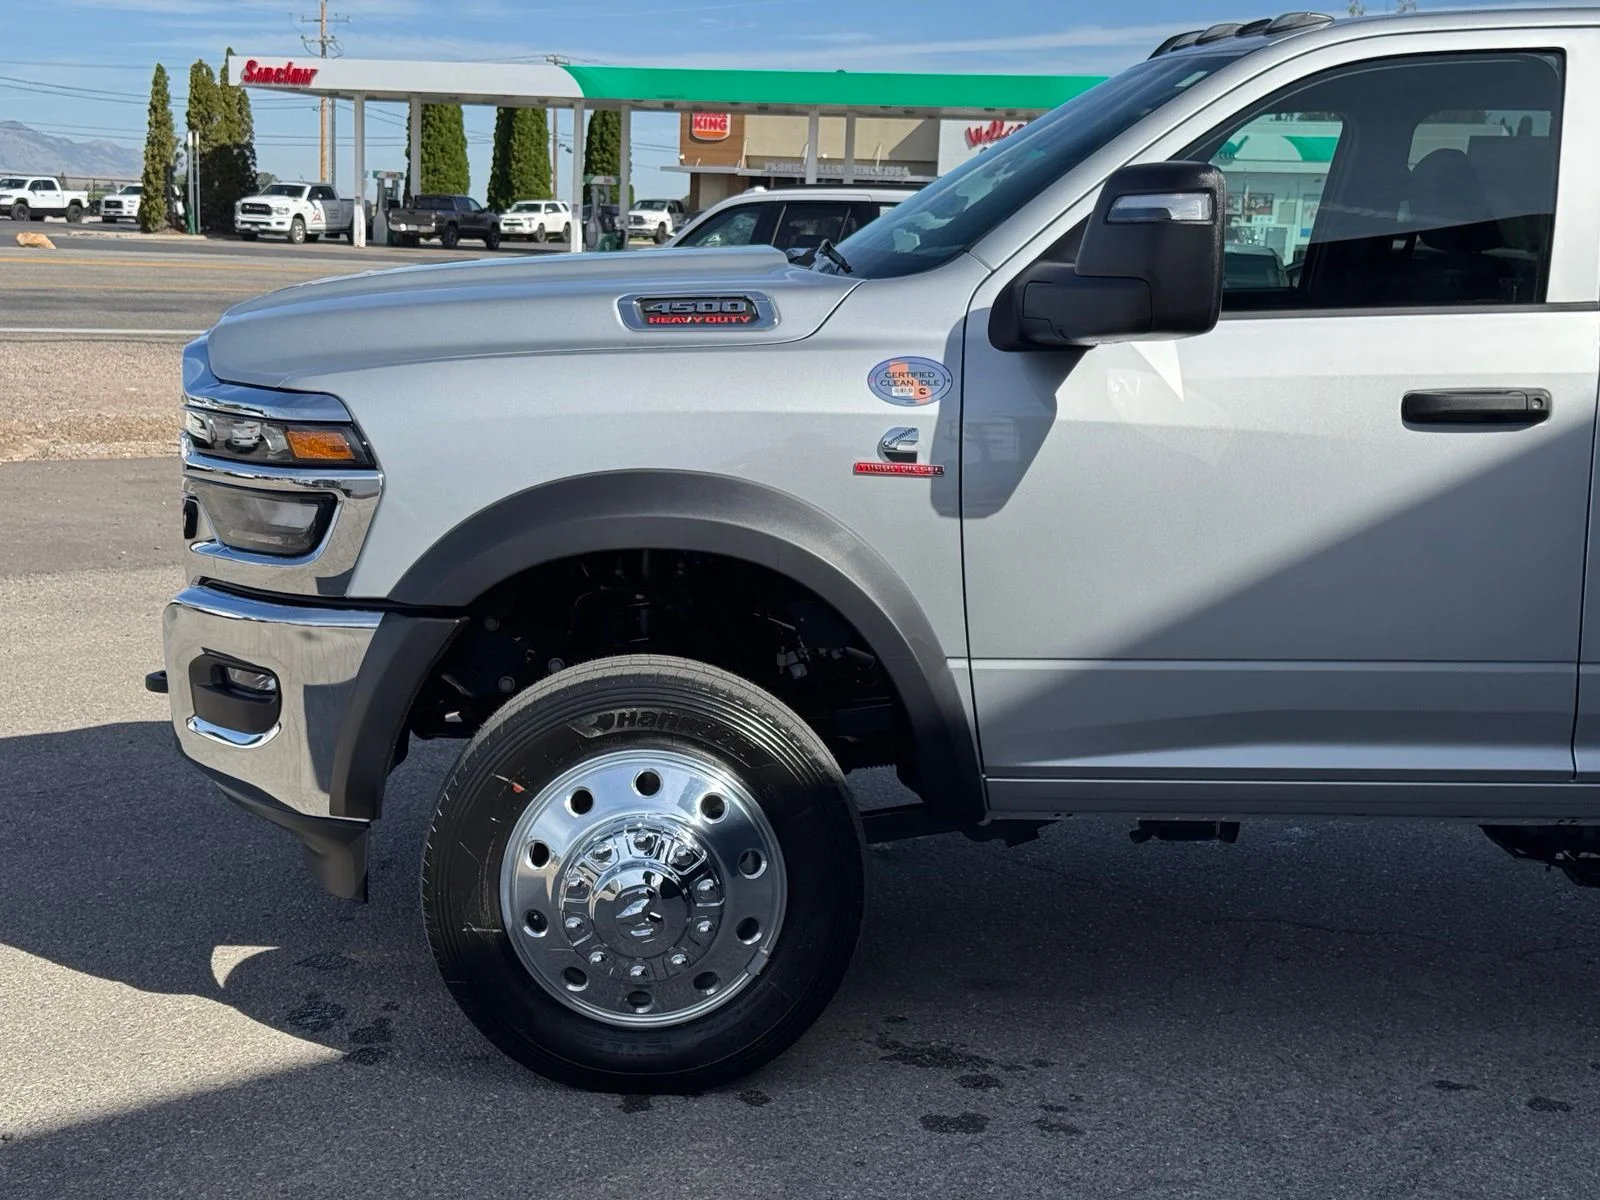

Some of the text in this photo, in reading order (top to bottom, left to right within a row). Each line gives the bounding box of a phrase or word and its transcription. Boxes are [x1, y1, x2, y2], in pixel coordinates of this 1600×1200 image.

[243, 59, 318, 85] Sinclair
[694, 118, 728, 130] KING
[643, 301, 747, 314] 4500
[648, 316, 751, 324] HEAVY DUTY
[885, 371, 935, 379] CERTIFIED
[880, 379, 940, 387] CLEAN IDLE
[882, 427, 917, 448] Cummins
